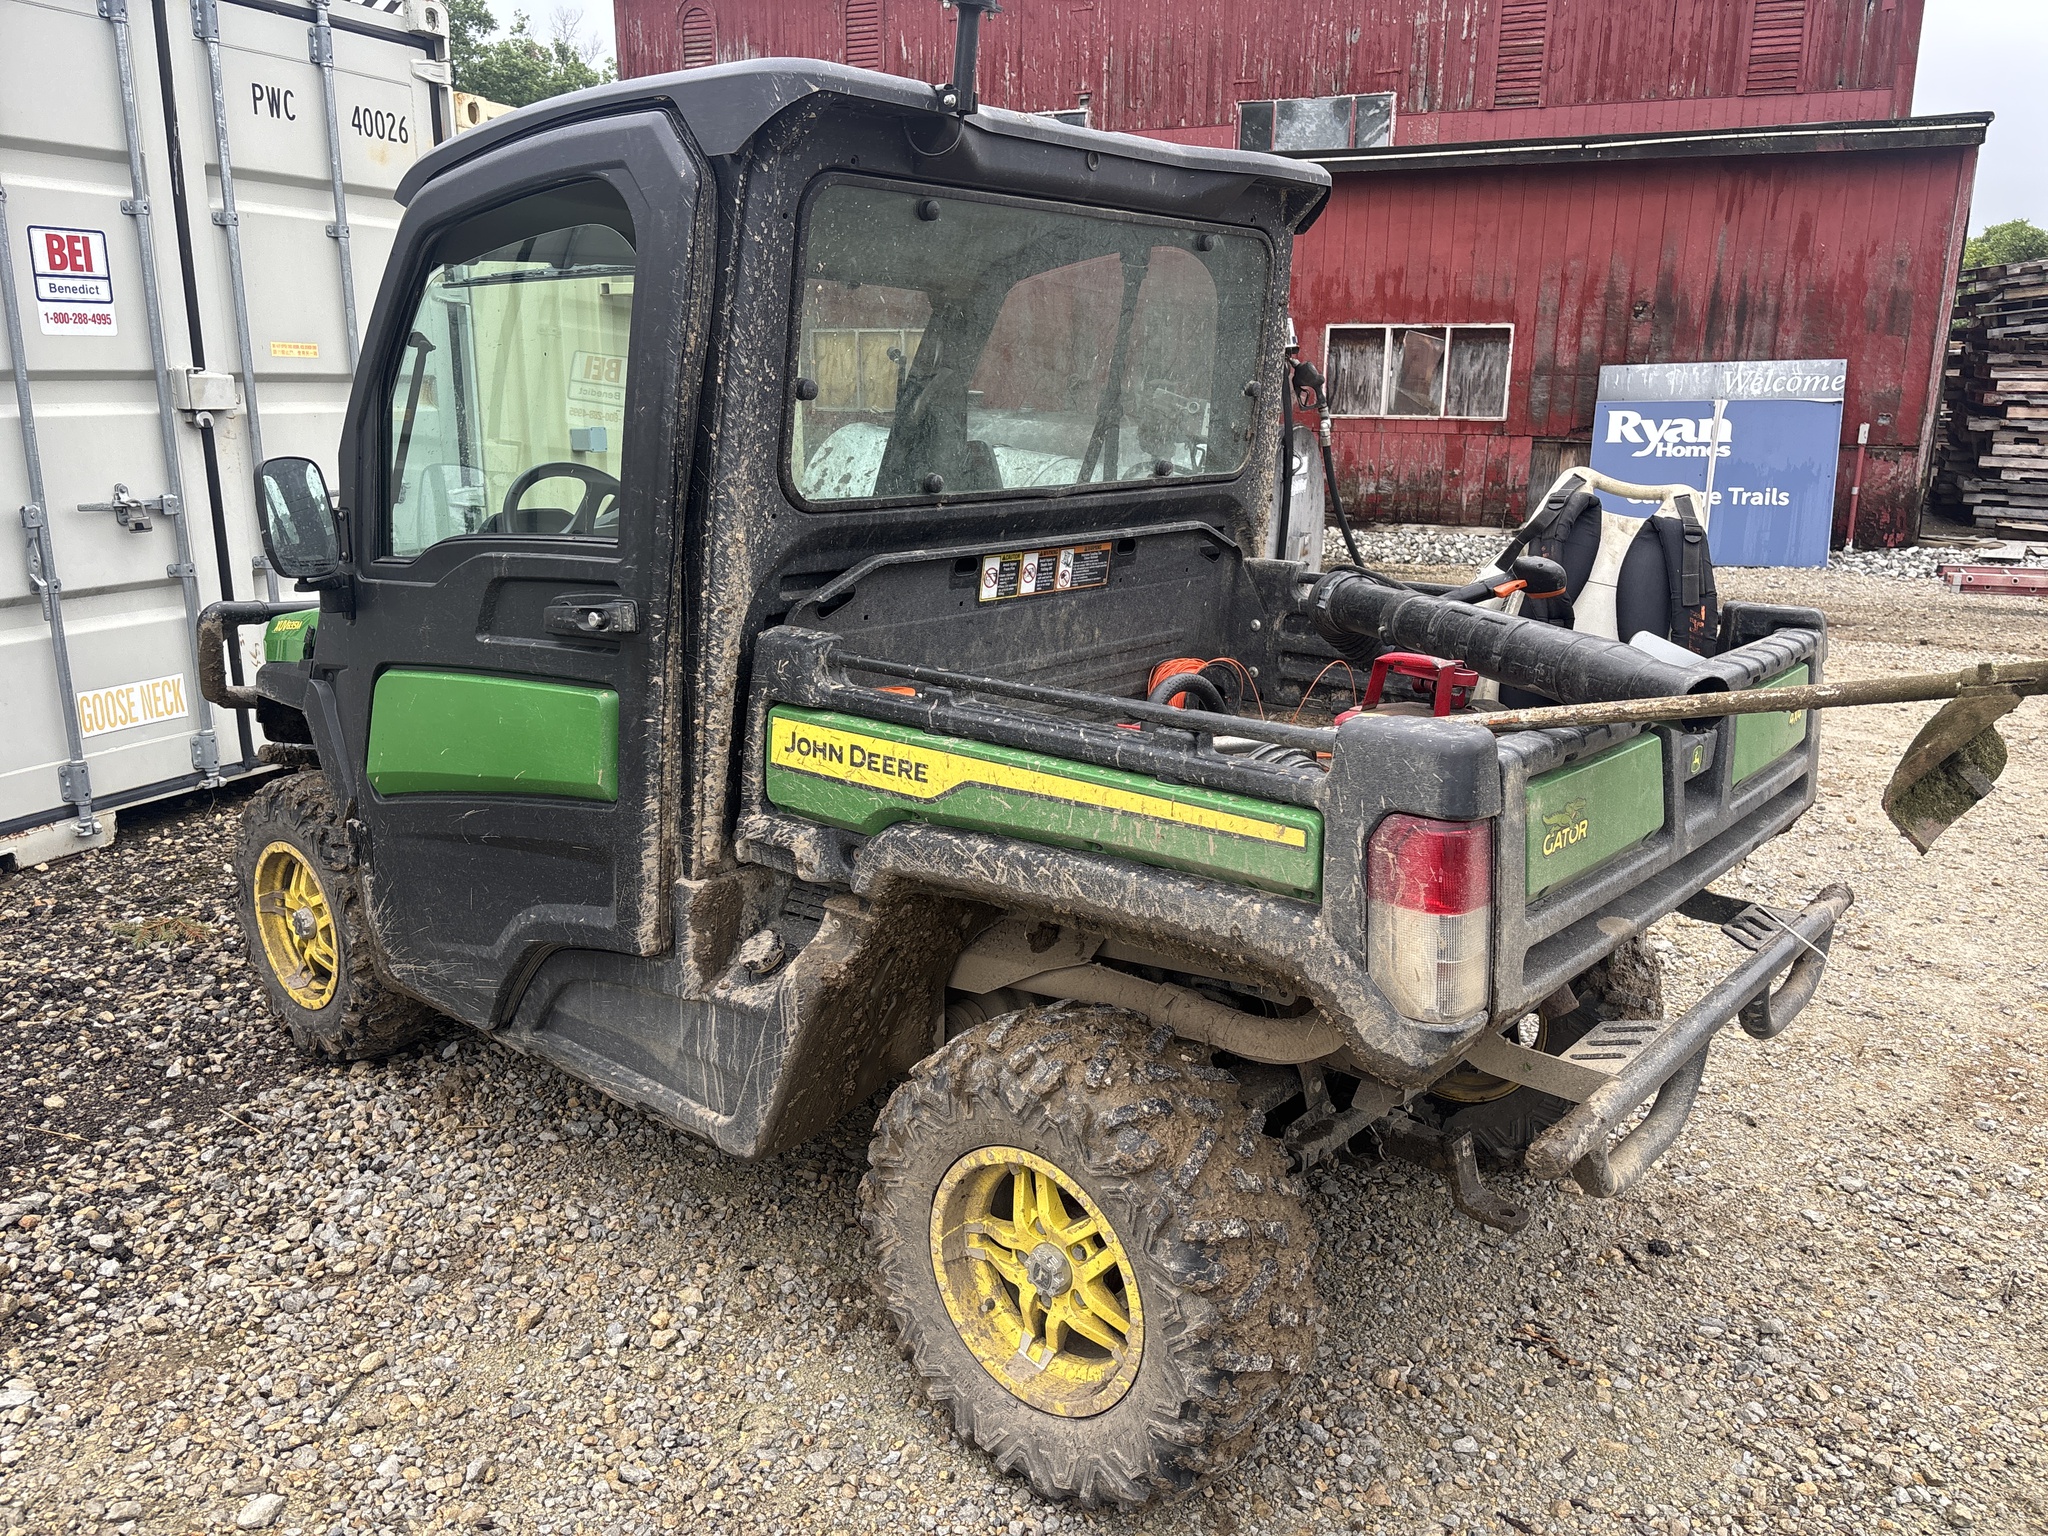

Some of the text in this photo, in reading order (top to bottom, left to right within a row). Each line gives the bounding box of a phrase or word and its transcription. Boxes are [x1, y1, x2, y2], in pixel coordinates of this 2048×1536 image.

[251, 82, 409, 144] PWC 40026
[45, 233, 93, 272] BEI
[48, 282, 101, 295] Benedict
[44, 312, 112, 325] 1-800-288-4995
[1723, 369, 1846, 394] Welcome
[1604, 410, 1733, 457] Ryan
[1655, 442, 1731, 458] Homes
[1728, 487, 1790, 506] Trails
[80, 678, 186, 733] GOOSE NECK
[784, 731, 929, 783] JOHN DEERE
[1543, 819, 1588, 856] GATOR
